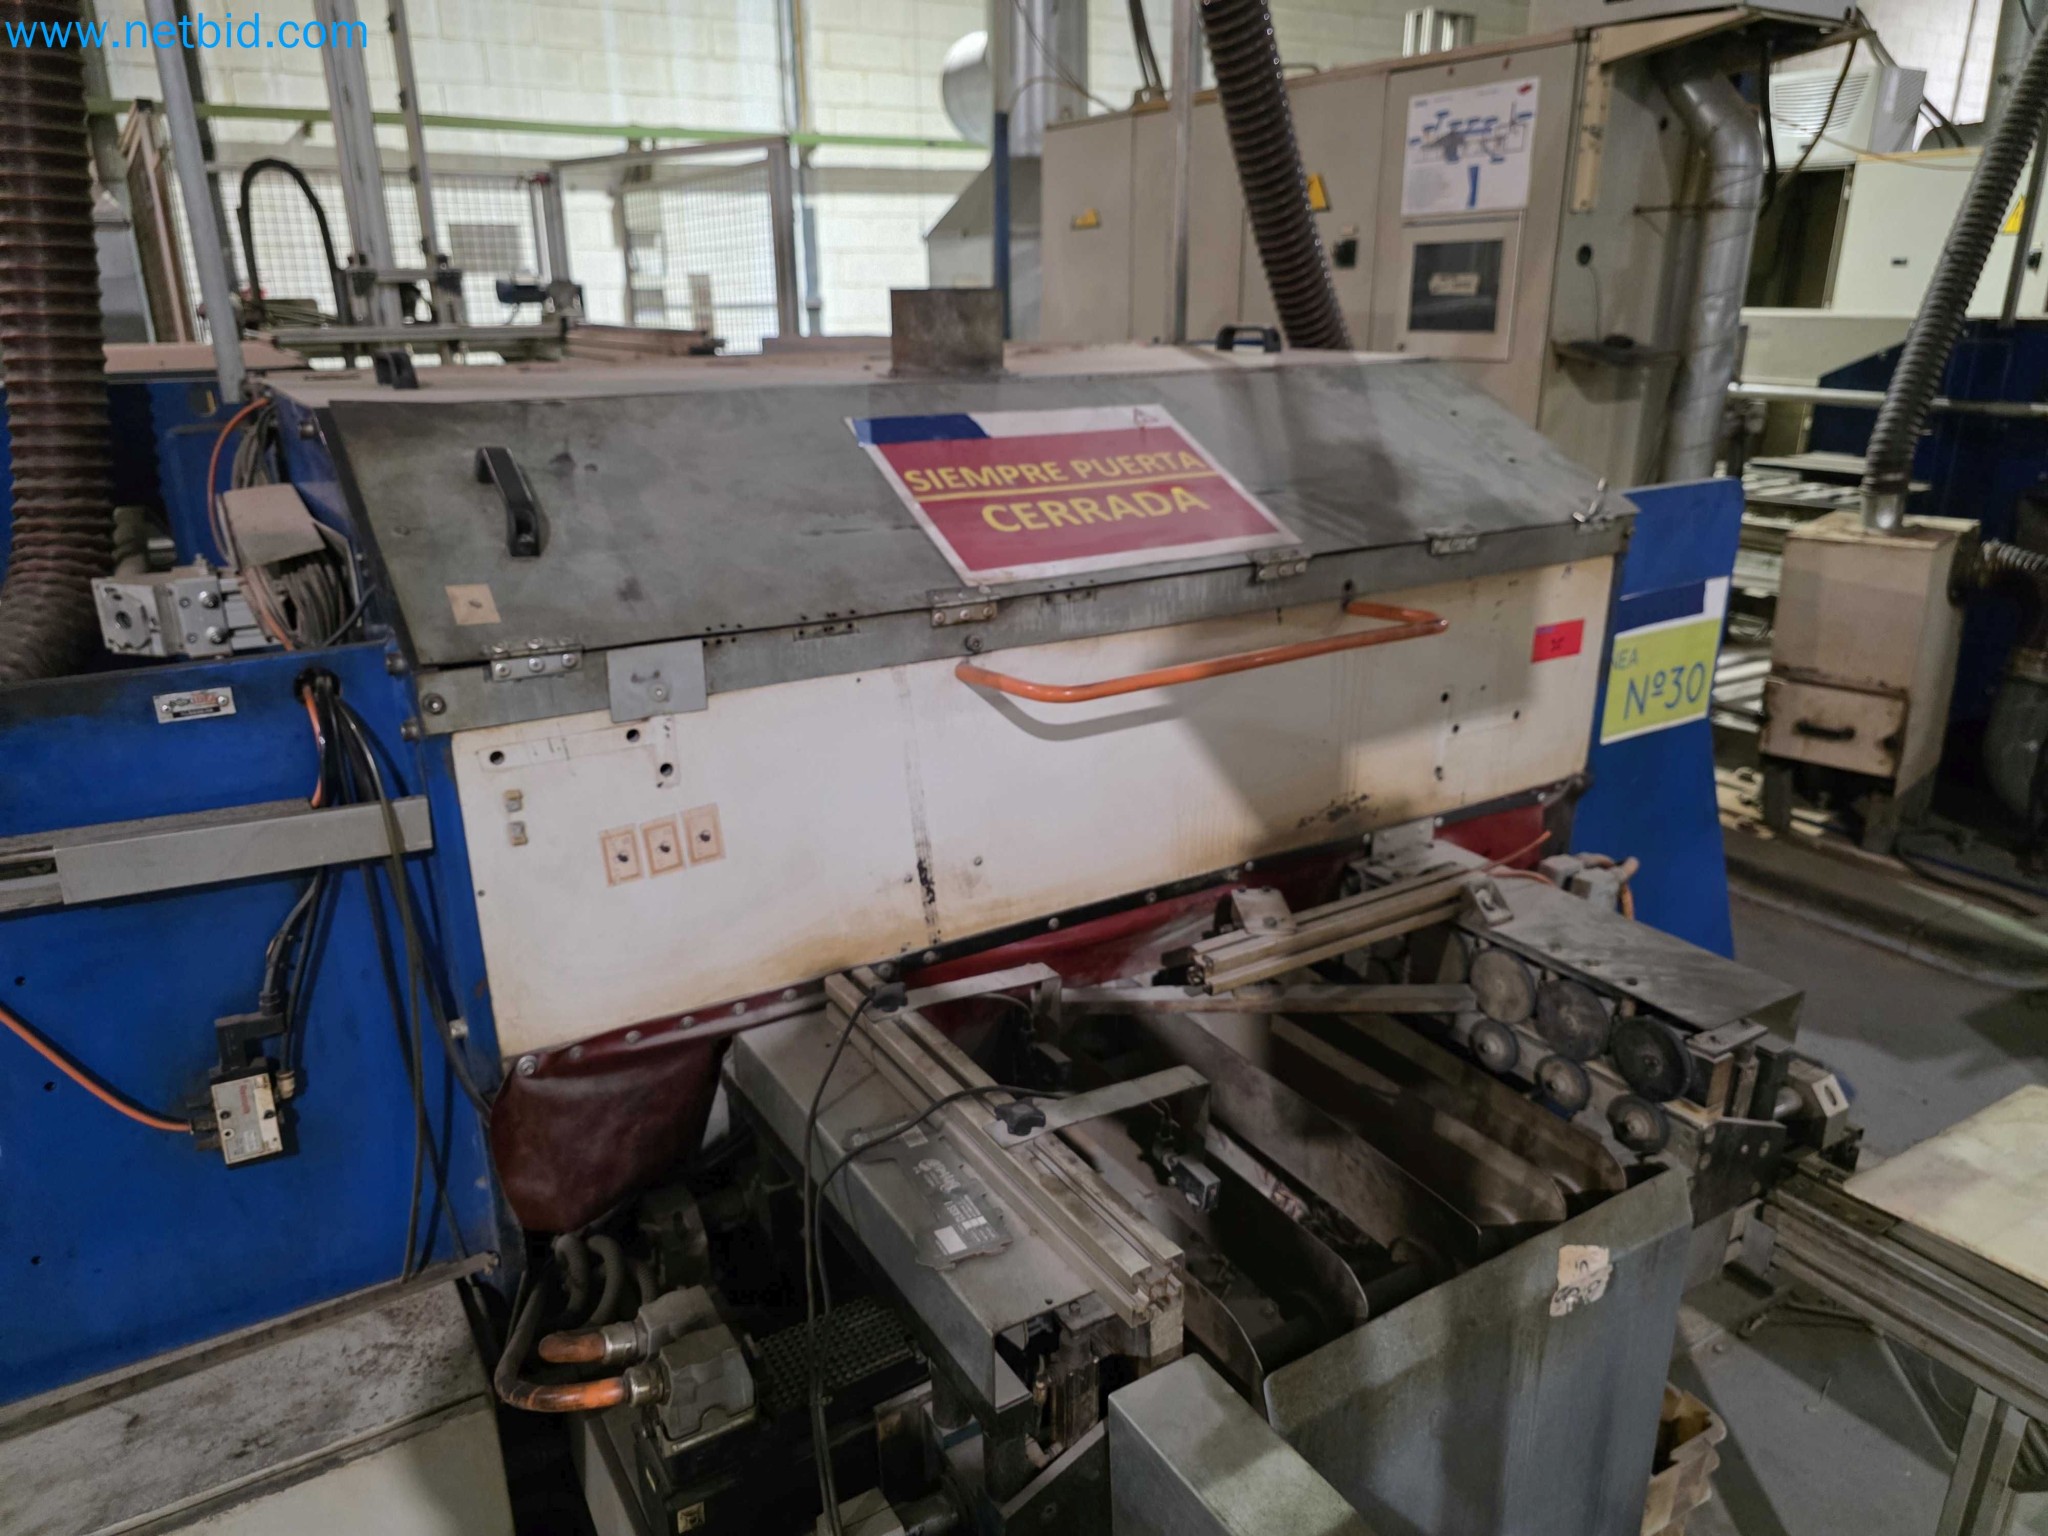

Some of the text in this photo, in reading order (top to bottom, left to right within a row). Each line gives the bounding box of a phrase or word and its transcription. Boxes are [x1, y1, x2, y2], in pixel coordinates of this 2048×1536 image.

[904, 450, 1207, 493] SIEMPRE PUERTA
[982, 486, 1212, 533] CERRADA
